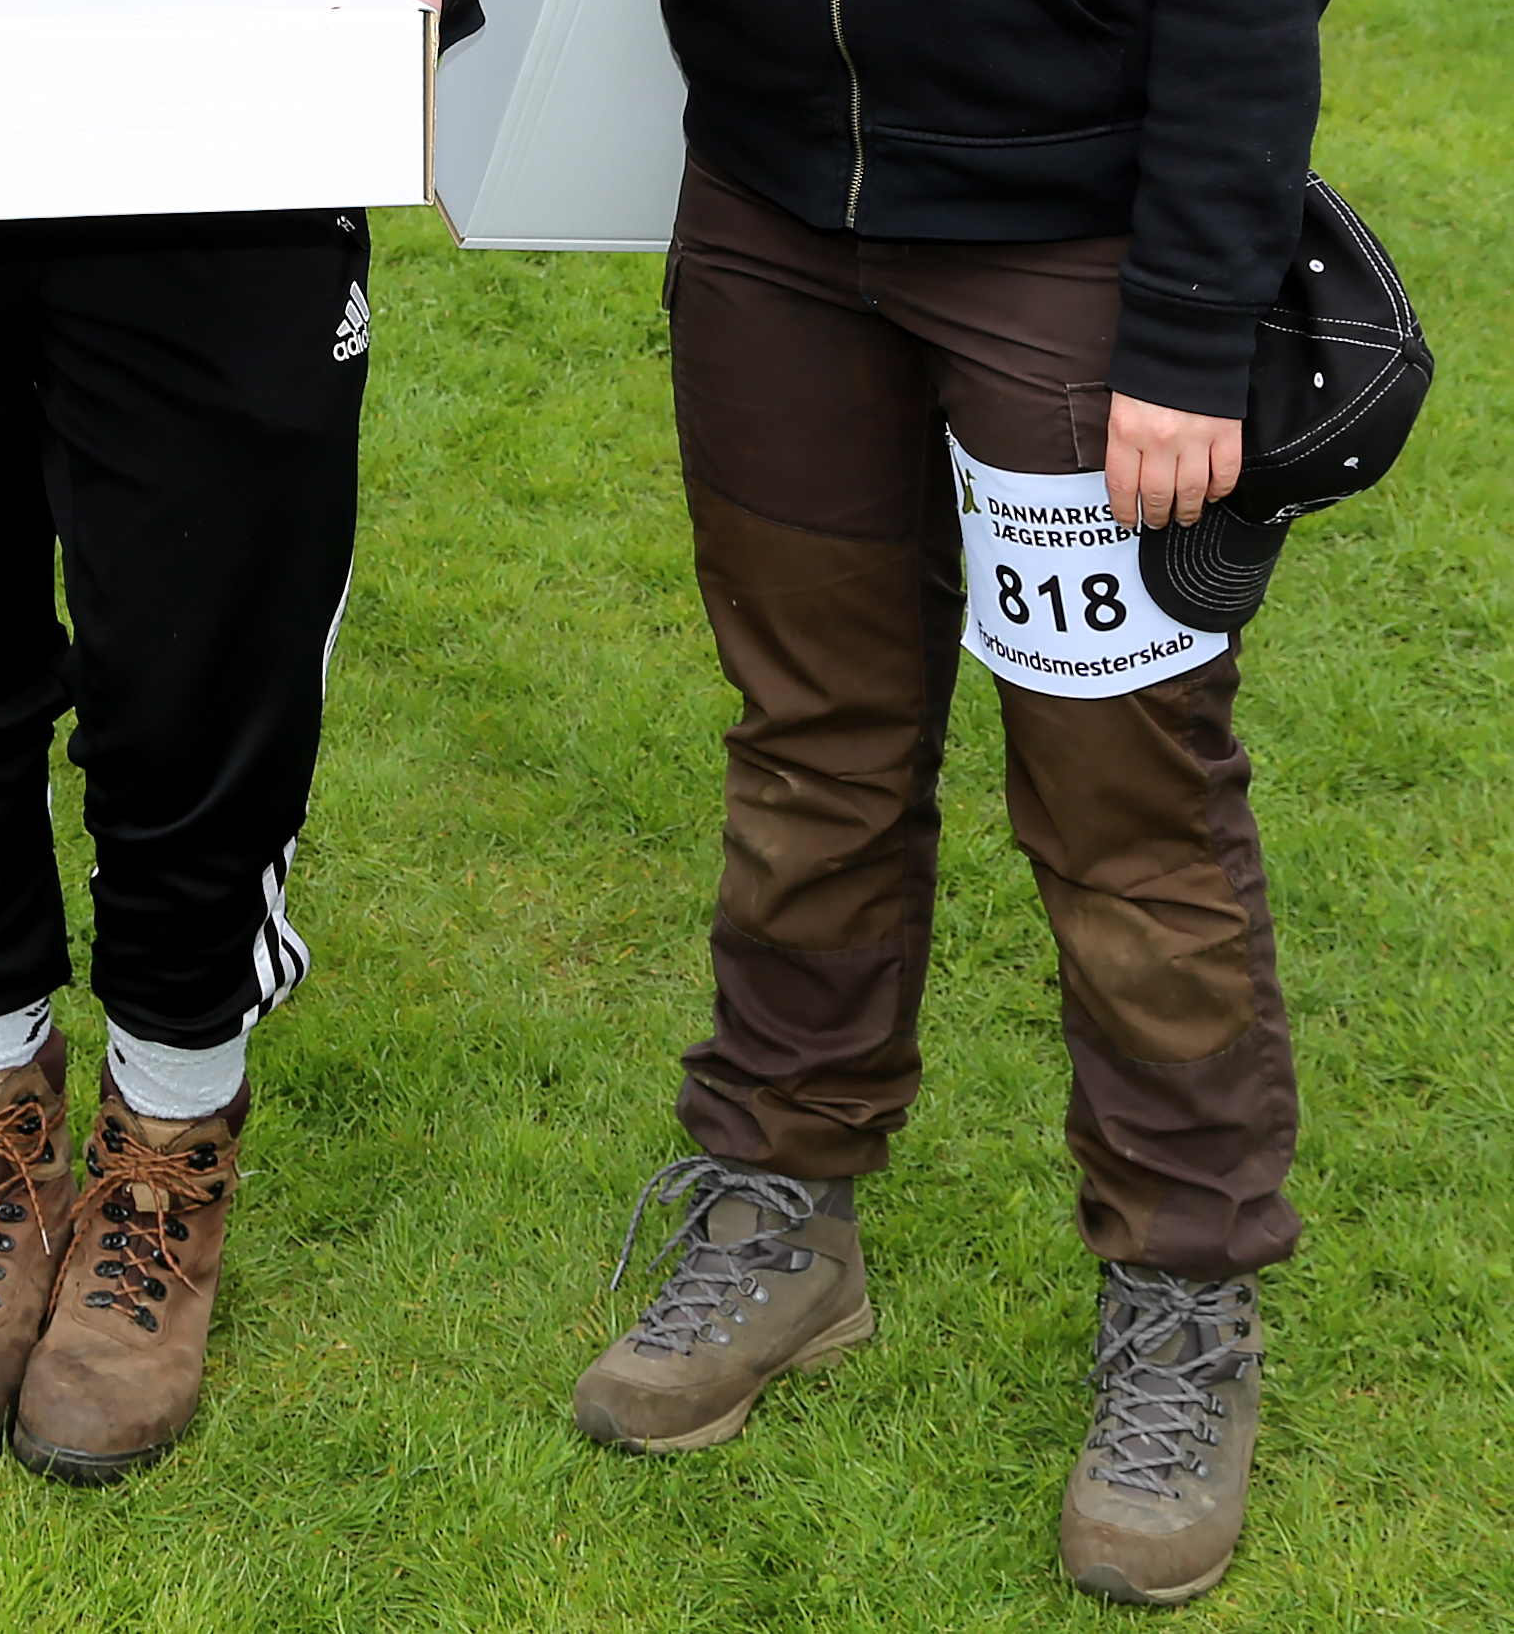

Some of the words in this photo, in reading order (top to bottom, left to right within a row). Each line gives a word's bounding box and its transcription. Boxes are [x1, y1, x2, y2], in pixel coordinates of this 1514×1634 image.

[986, 496, 1115, 527] DANMARKS
[995, 564, 1128, 634] 818
[976, 618, 1195, 678] Forbundsmesterskab
